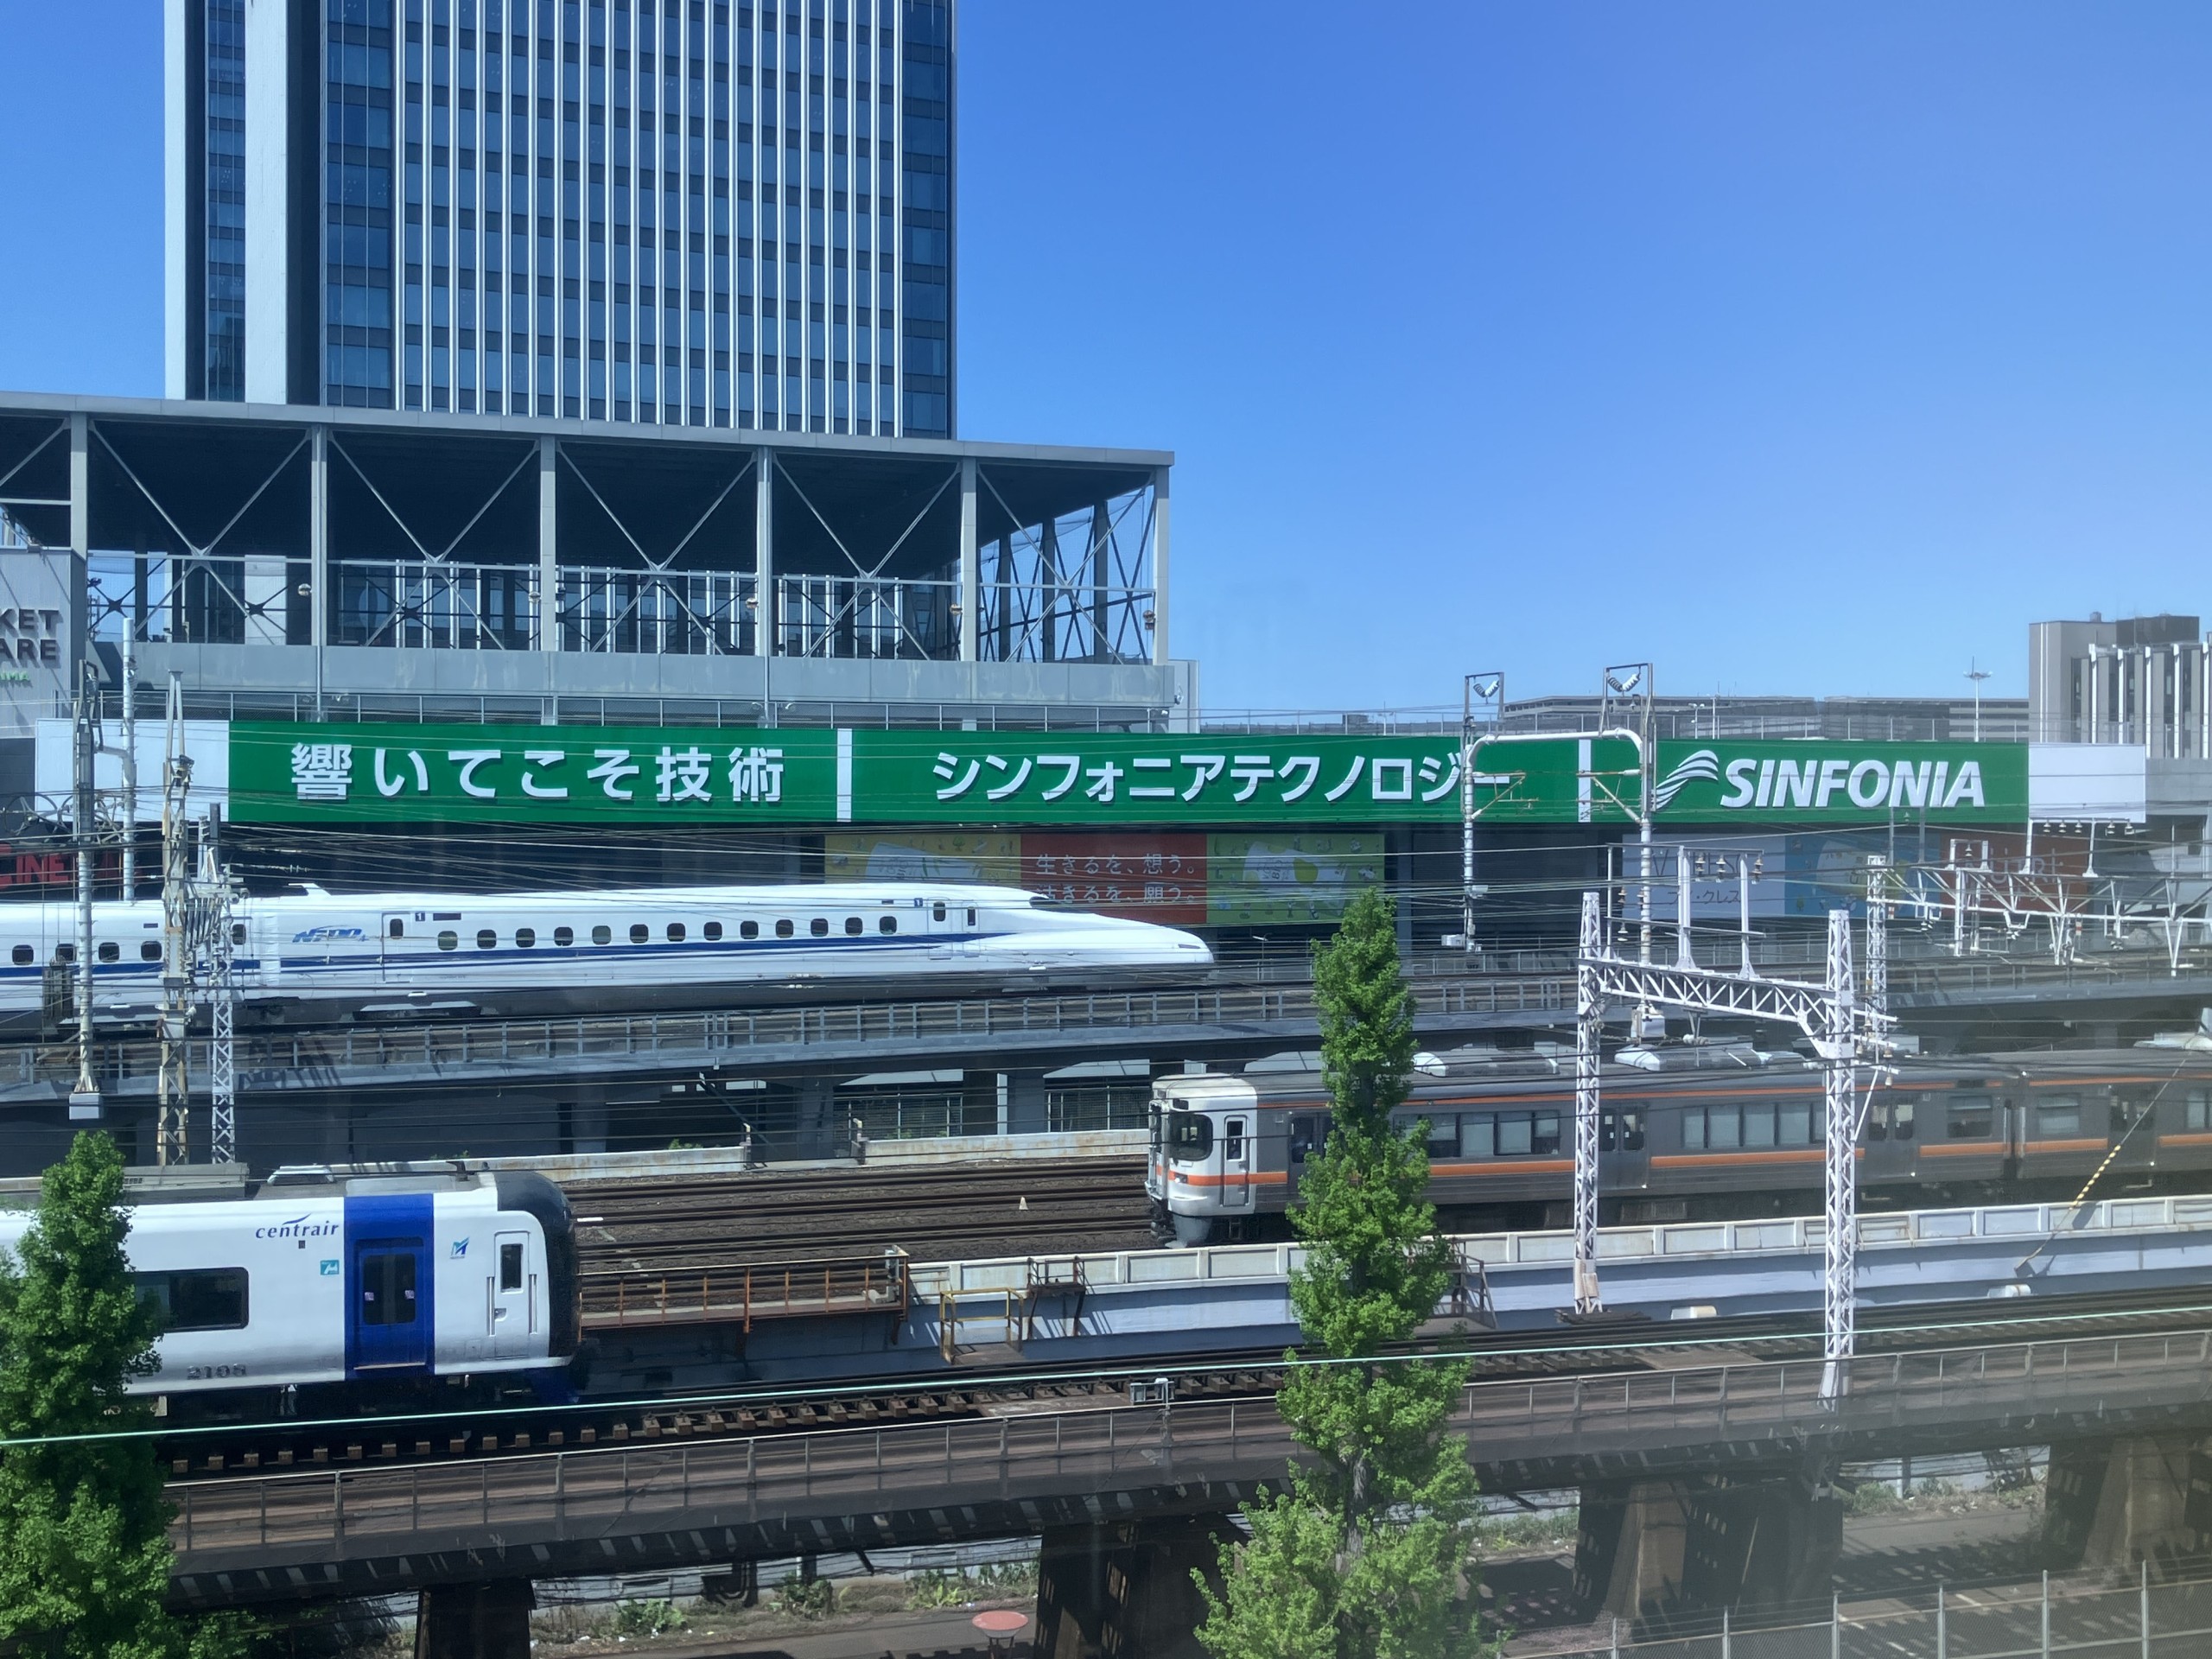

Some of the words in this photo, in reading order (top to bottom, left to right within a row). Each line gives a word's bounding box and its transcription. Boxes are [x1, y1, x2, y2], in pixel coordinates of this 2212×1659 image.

[291, 742, 783, 803] 響いてこそ技術
[933, 750, 1510, 802] シンフォニアテクノロジー
[1719, 758, 1986, 808] SINFONIA
[1037, 853, 1195, 874] 生きるを、想う。
[256, 1219, 339, 1238] centrair
